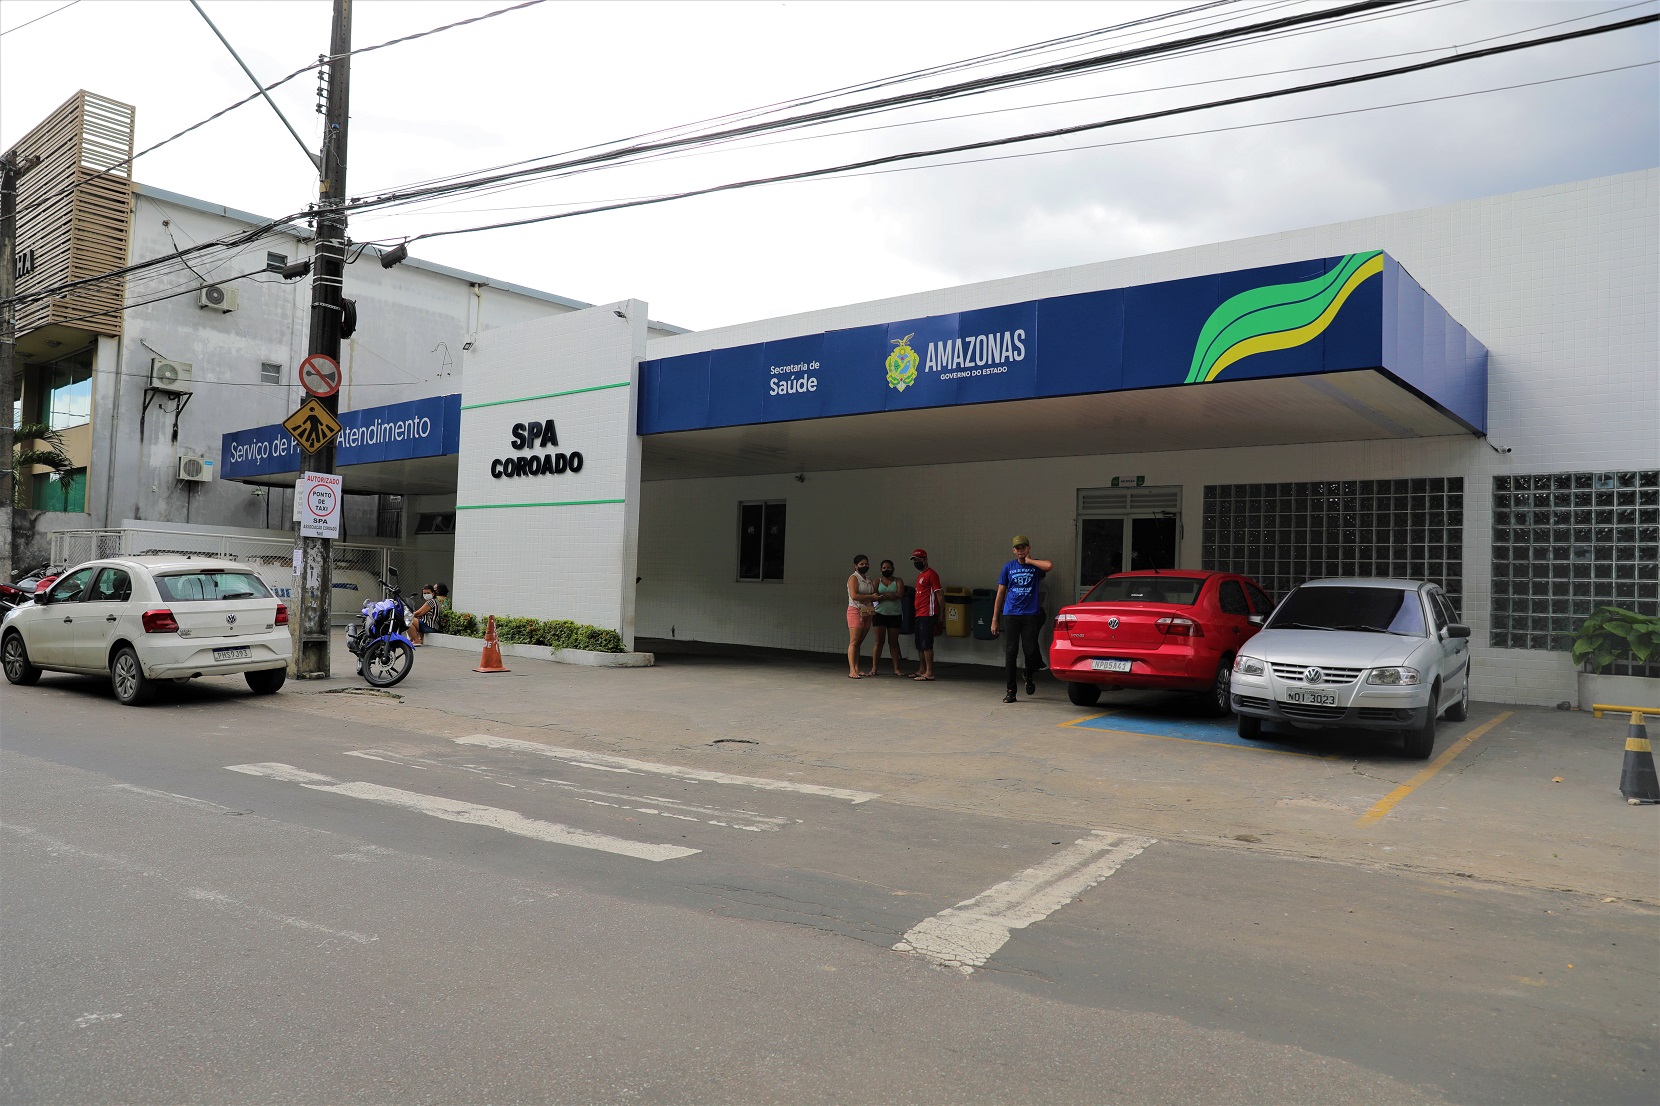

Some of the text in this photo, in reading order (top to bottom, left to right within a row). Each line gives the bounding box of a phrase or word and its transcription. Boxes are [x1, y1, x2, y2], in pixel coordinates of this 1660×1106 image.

[925, 329, 1026, 373] AMAZONAS
[770, 361, 820, 375] Secretaria de
[940, 366, 1008, 380] GOVERNO DO ESTADO
[769, 374, 818, 396] Saúde
[230, 439, 270, 466] Serviço
[272, 434, 288, 457] de
[336, 415, 431, 448] Atendimento
[511, 419, 559, 450] SPA
[490, 451, 584, 479] COROADO
[306, 475, 340, 486] AUTORIZADO
[312, 490, 332, 499] PONTO
[312, 517, 328, 525] SPA
[1310, 694, 1335, 705] 3023
